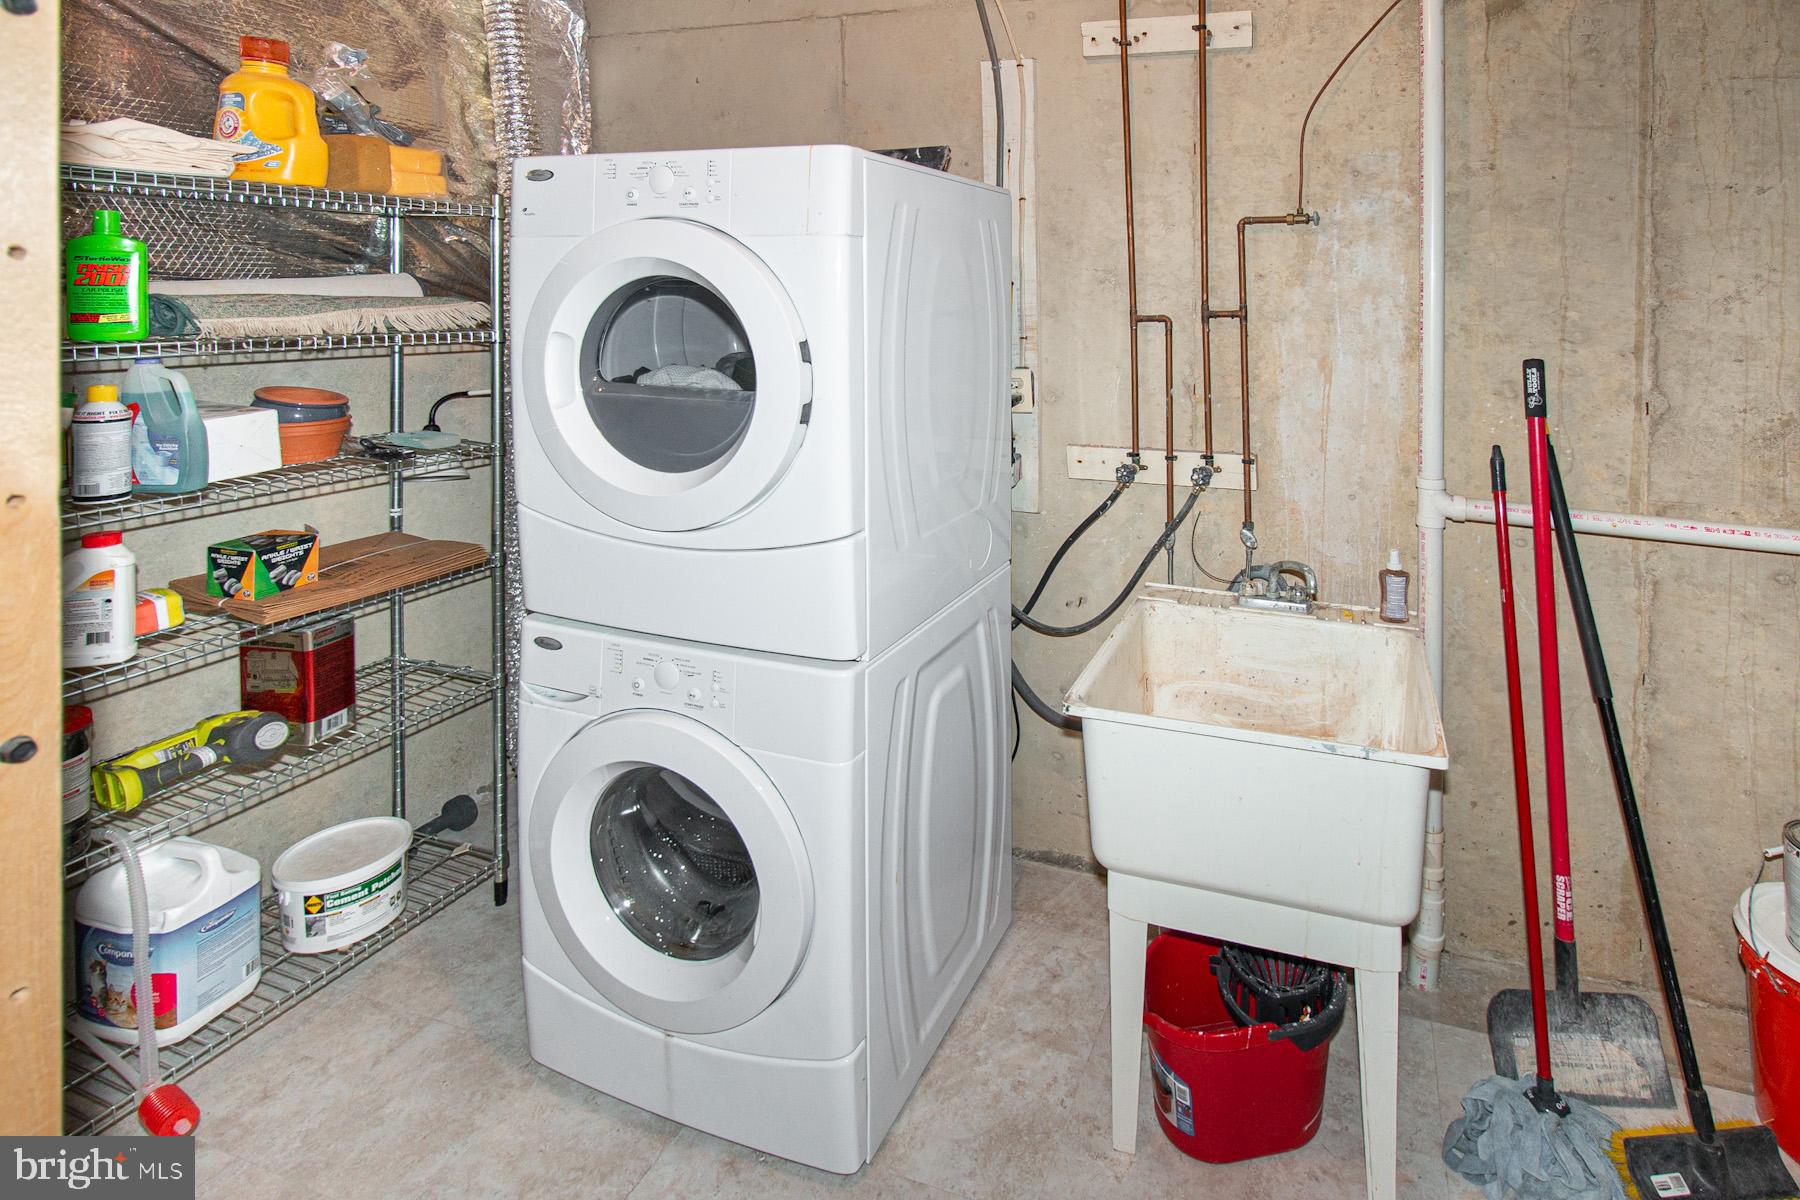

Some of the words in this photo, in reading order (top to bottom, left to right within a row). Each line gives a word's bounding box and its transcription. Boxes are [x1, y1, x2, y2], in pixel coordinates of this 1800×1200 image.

[1530, 367, 1538, 394] TOOLS
[261, 549, 286, 561] ANKLE
[289, 542, 313, 555] WRIST
[271, 550, 305, 564] WEIGHTS
[326, 887, 369, 909] Cement
[1555, 874, 1567, 922] SCRAPER
